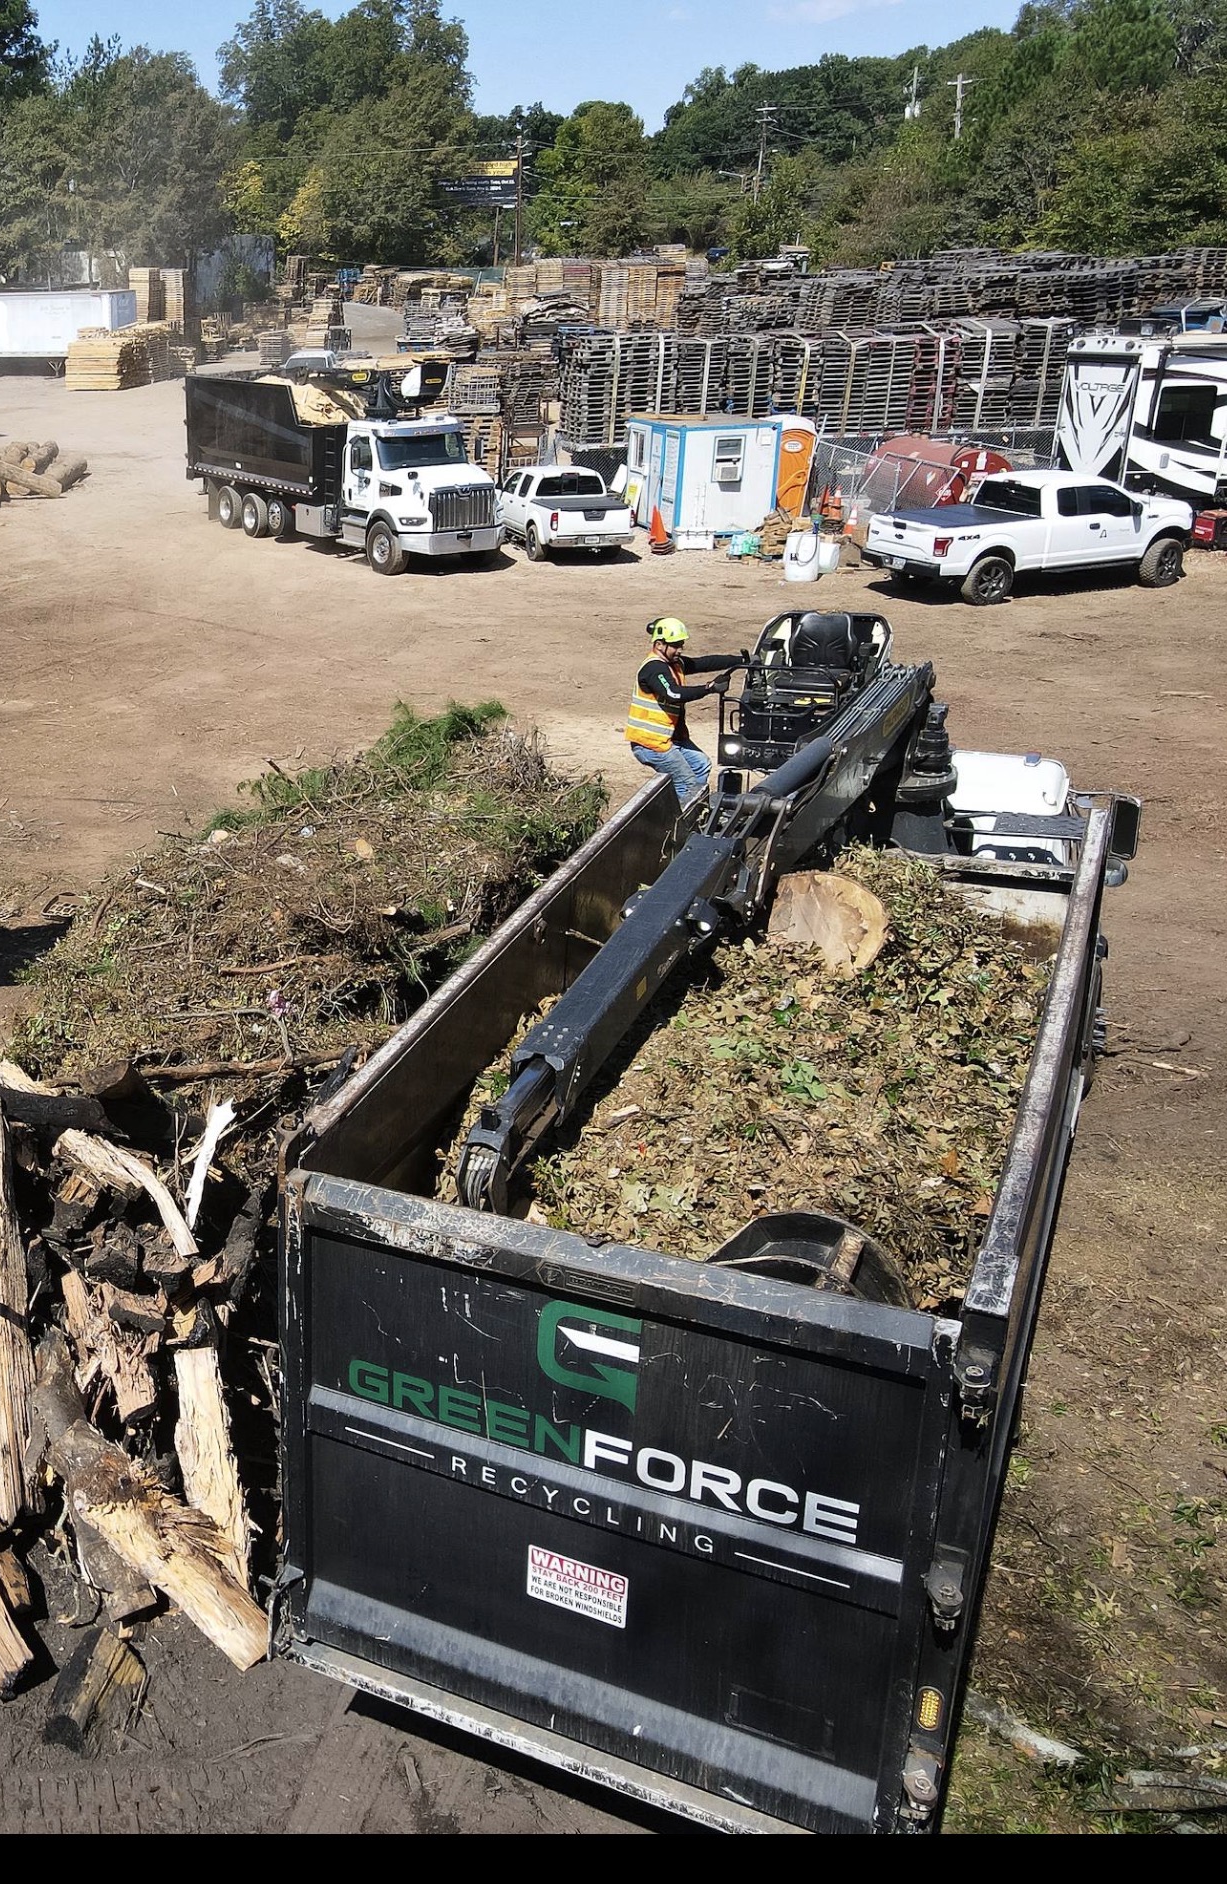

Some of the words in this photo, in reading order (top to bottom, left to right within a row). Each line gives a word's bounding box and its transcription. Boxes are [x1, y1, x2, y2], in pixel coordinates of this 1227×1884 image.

[1074, 382, 1126, 393] VOLTAGE
[451, 1456, 714, 1555] RECYCLING
[532, 1549, 625, 1593] WARNING
[532, 1566, 554, 1578] STAY
[556, 1573, 580, 1588] BACK
[583, 1583, 599, 1594] 200
[601, 1590, 624, 1603] FEET
[530, 1585, 544, 1596] FOR
[545, 1591, 574, 1606] BROKEN
[575, 1601, 622, 1624] WINDSHIELDS
[532, 1575, 542, 1584] WE
[543, 1579, 557, 1590] ARE
[558, 1584, 573, 1596] NOT
[574, 1590, 622, 1613] RESPONSIBLE
